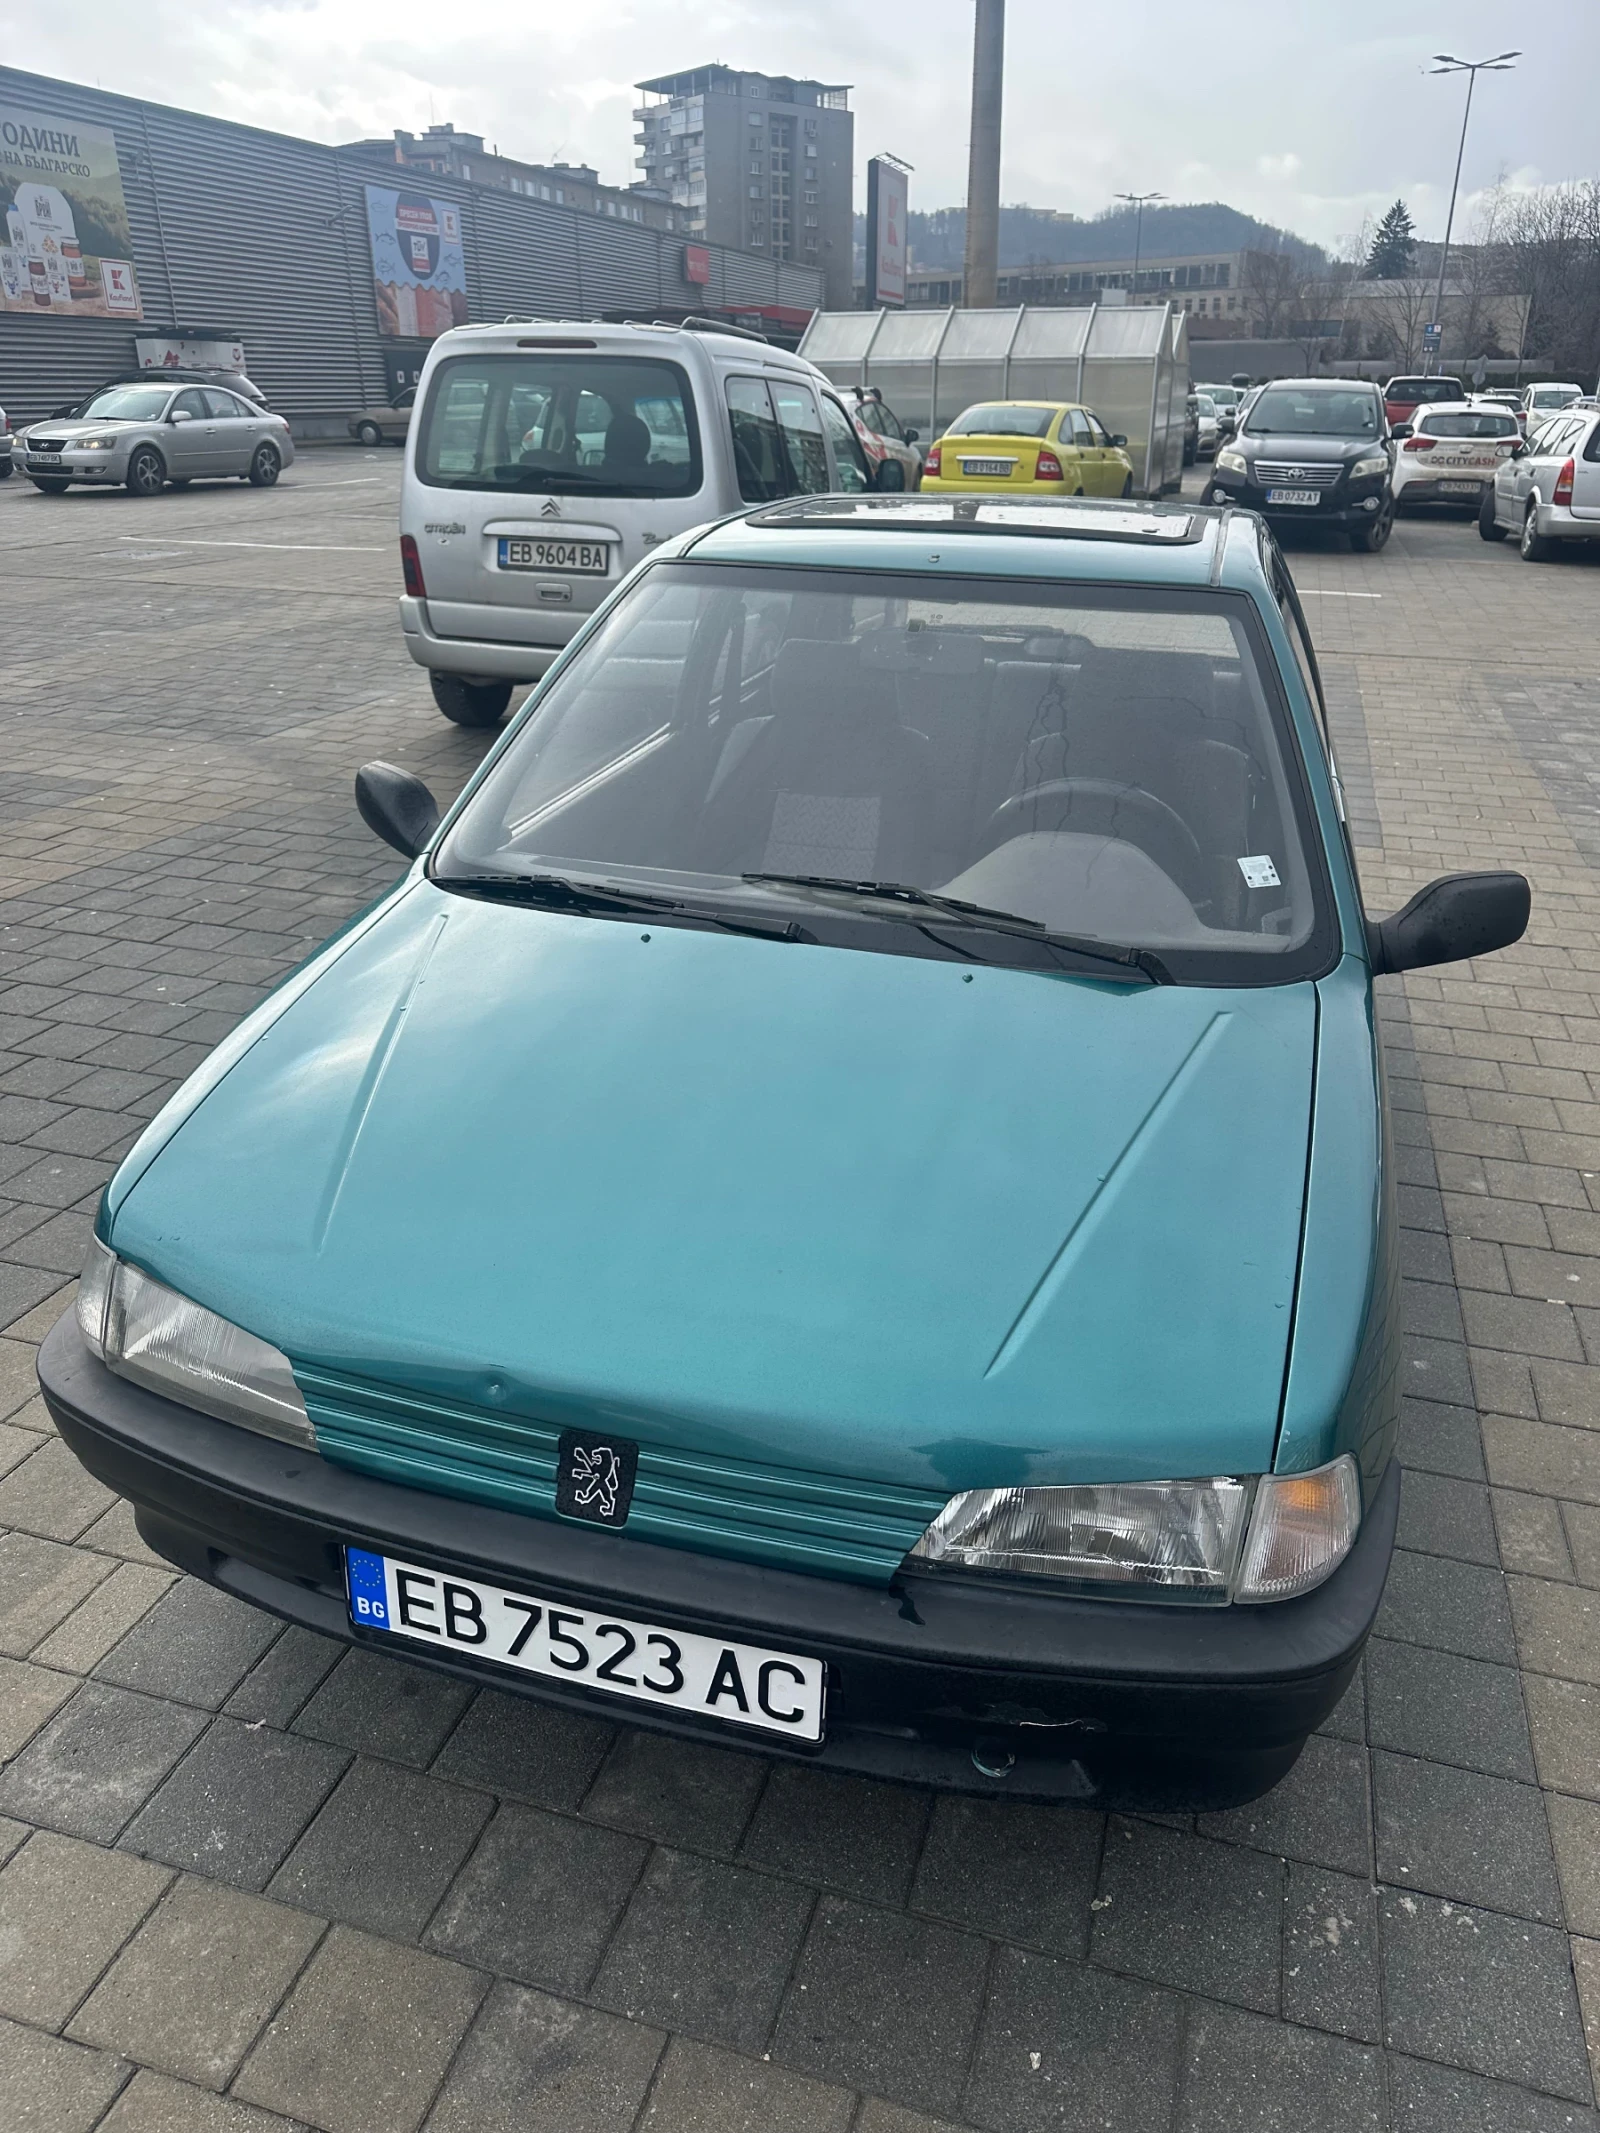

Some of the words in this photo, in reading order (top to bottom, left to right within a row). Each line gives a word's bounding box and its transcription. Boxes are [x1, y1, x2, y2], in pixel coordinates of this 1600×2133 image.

[0, 121, 81, 157] ОДИНИ
[4, 150, 23, 165] НА
[24, 154, 91, 177] БЪЛГАРСКО
[509, 542, 532, 563] EB
[536, 544, 577, 566] 9604
[580, 546, 603, 568] BA
[357, 1596, 385, 1619] BG
[396, 1568, 487, 1645] EB
[503, 1597, 685, 1694] 7523
[704, 1647, 806, 1723] AC
